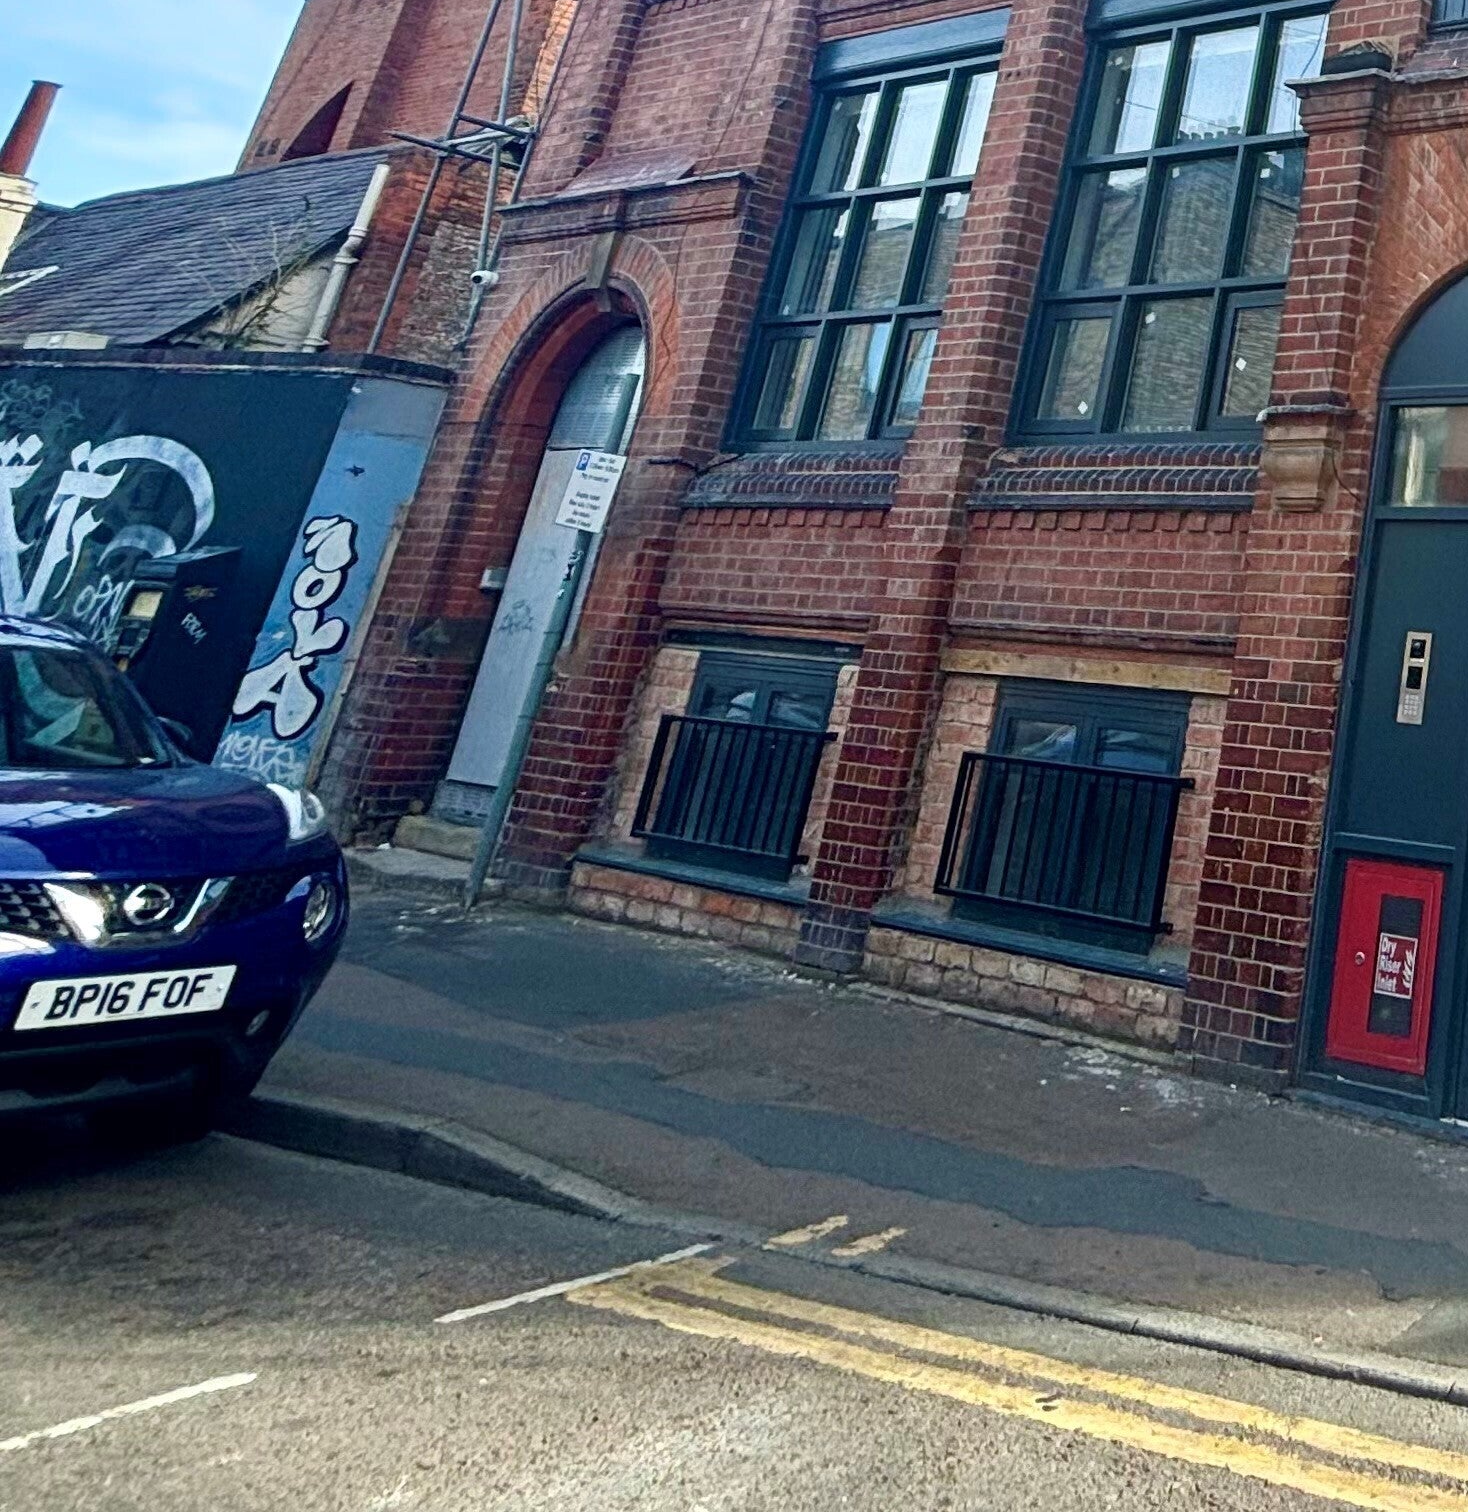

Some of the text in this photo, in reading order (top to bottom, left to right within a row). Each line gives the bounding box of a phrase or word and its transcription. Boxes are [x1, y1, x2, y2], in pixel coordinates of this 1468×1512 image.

[1381, 936, 1397, 959] Dry
[1380, 954, 1402, 975] Riser
[1376, 972, 1397, 992] Inlet
[43, 972, 214, 1021] BP16 FOF
